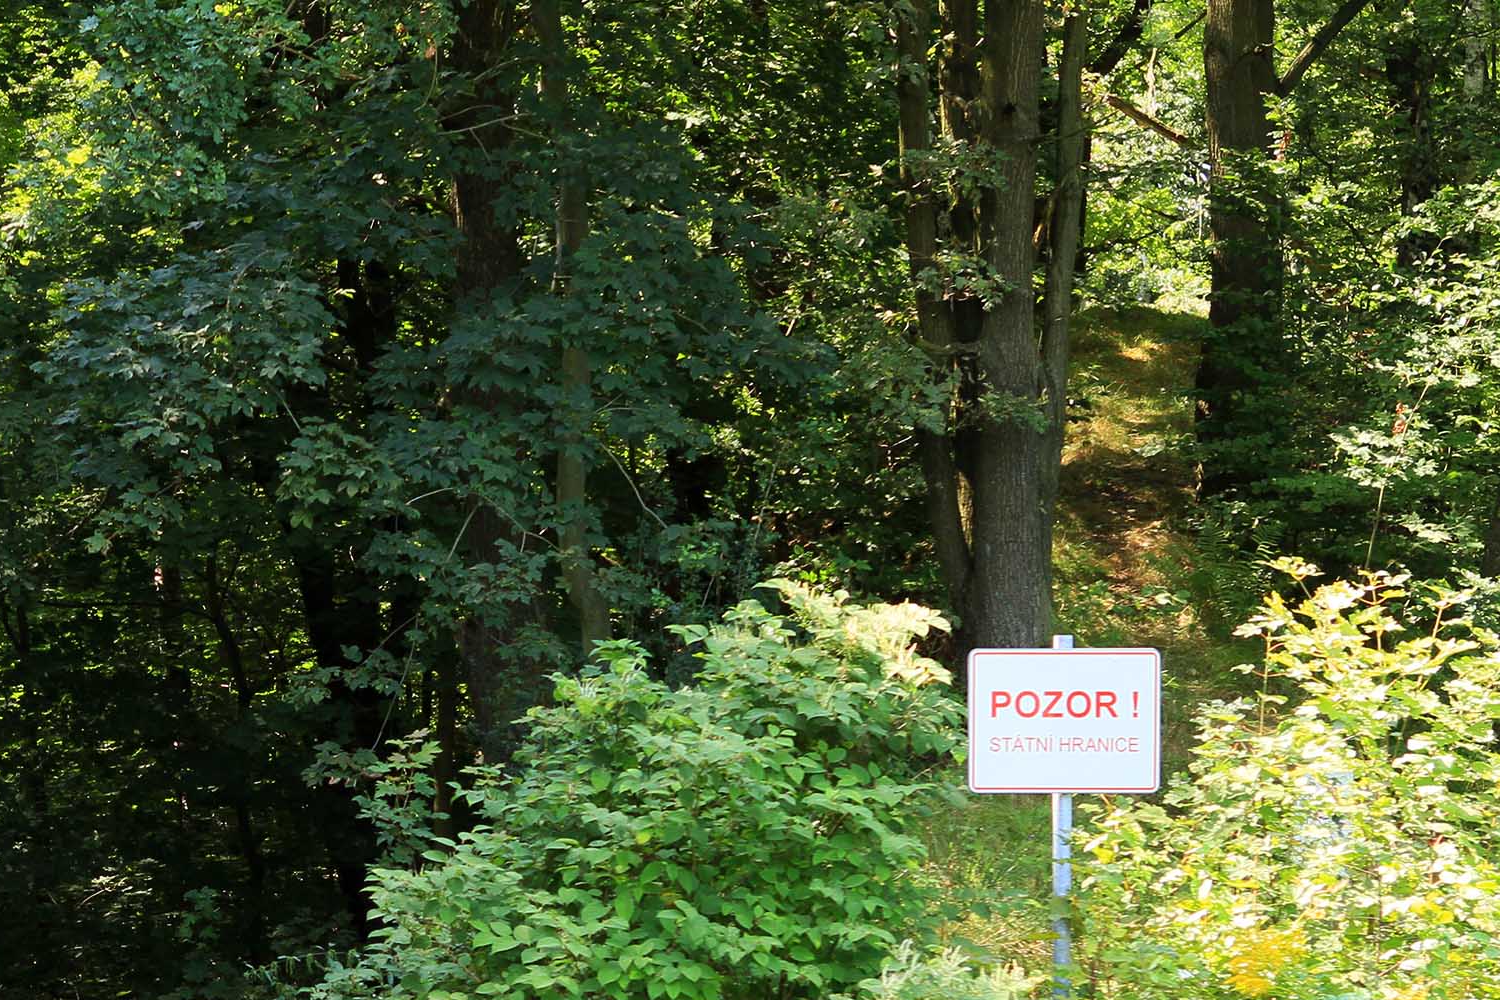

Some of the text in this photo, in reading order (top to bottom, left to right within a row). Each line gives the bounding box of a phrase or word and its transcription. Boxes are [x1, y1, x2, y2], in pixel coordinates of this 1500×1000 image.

[990, 690, 1118, 718] POZOR
[989, 734, 1139, 753] STÁTNÍ HRANICE
